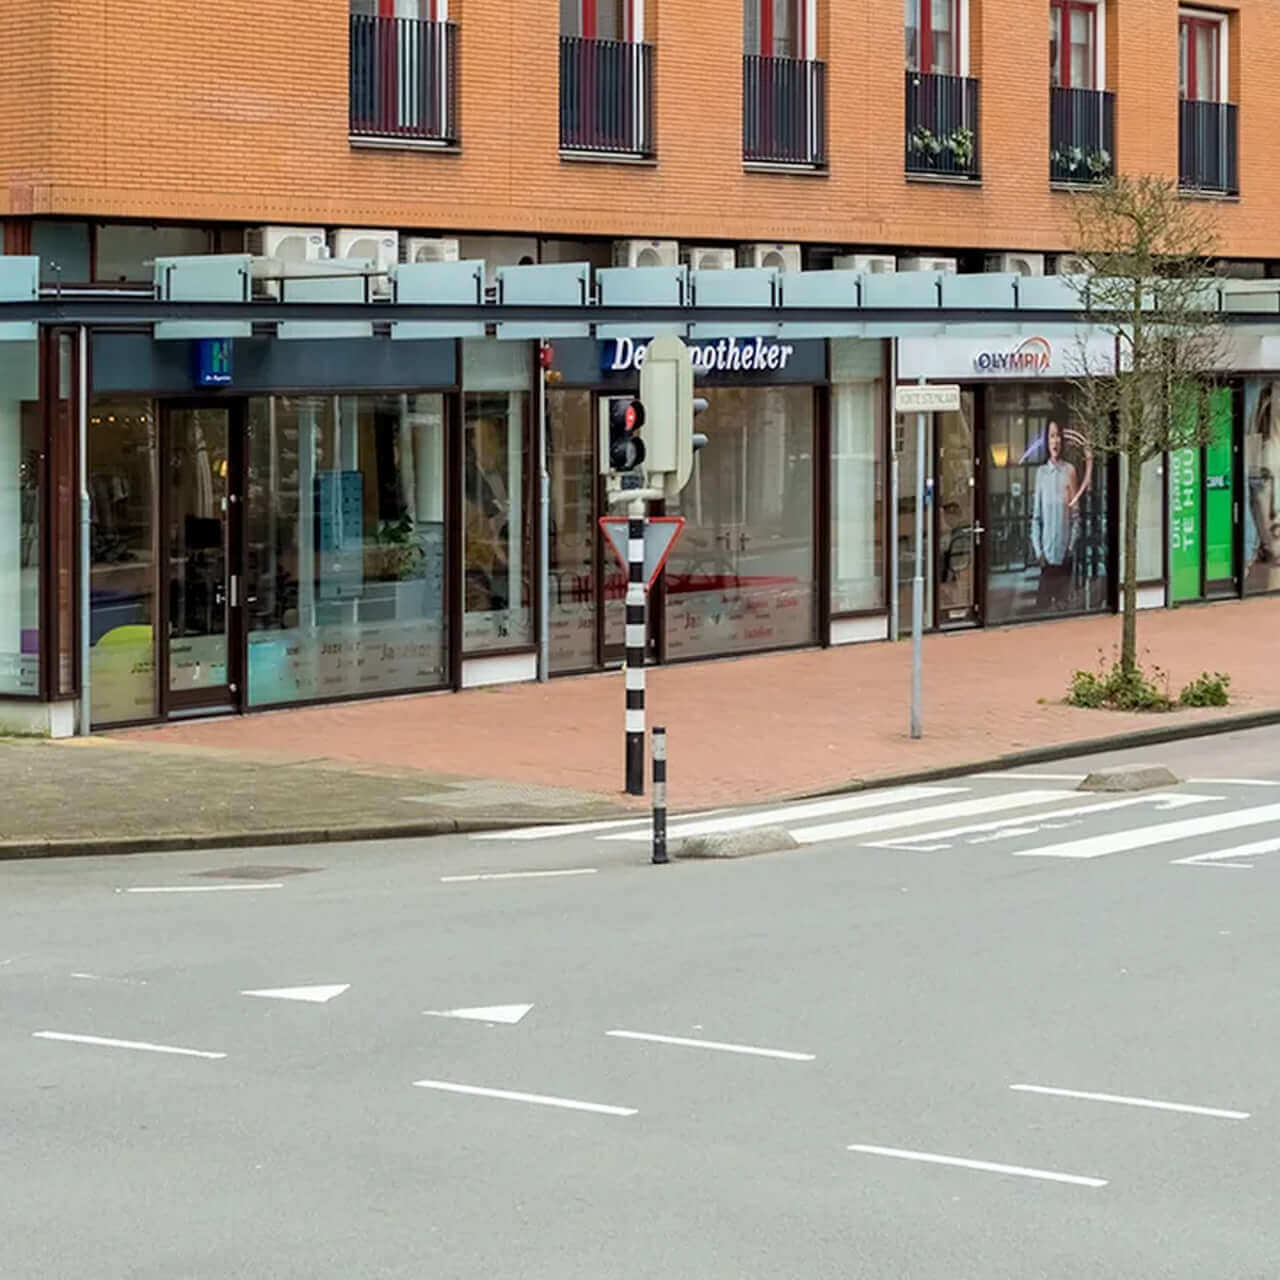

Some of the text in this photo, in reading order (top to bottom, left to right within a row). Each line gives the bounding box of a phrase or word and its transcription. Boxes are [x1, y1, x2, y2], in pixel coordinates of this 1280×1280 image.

[611, 336, 648, 370] De
[977, 351, 1051, 371] OLYMPIA
[1183, 516, 1195, 552] TE
